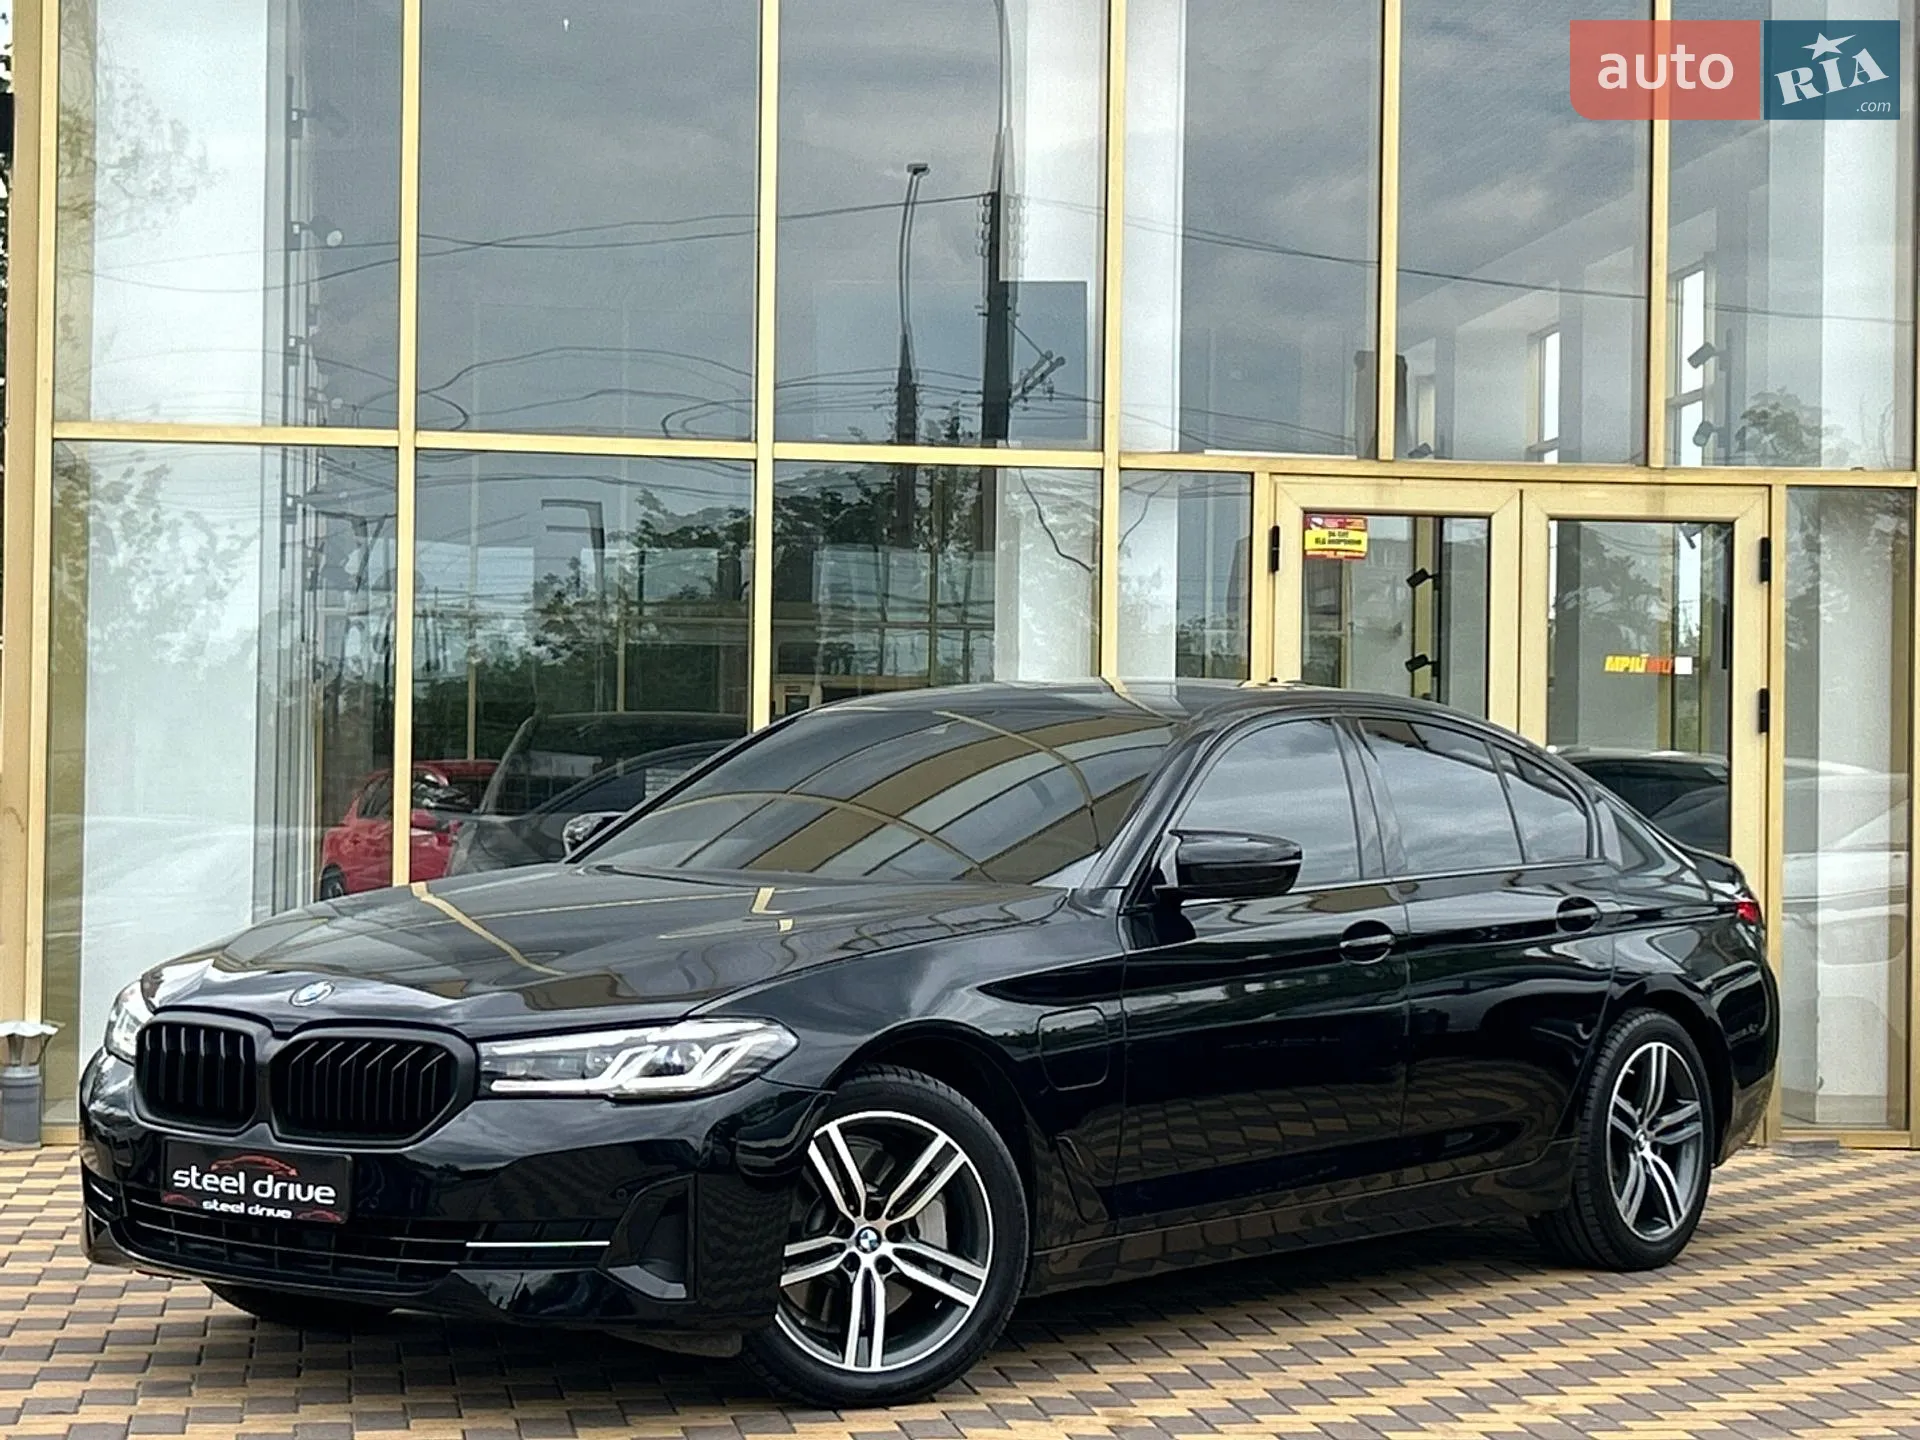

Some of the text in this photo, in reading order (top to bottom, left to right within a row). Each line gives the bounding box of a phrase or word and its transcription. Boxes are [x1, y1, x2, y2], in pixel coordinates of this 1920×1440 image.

[172, 1165, 337, 1205] steel drive
[202, 1198, 293, 1220] steel drive
